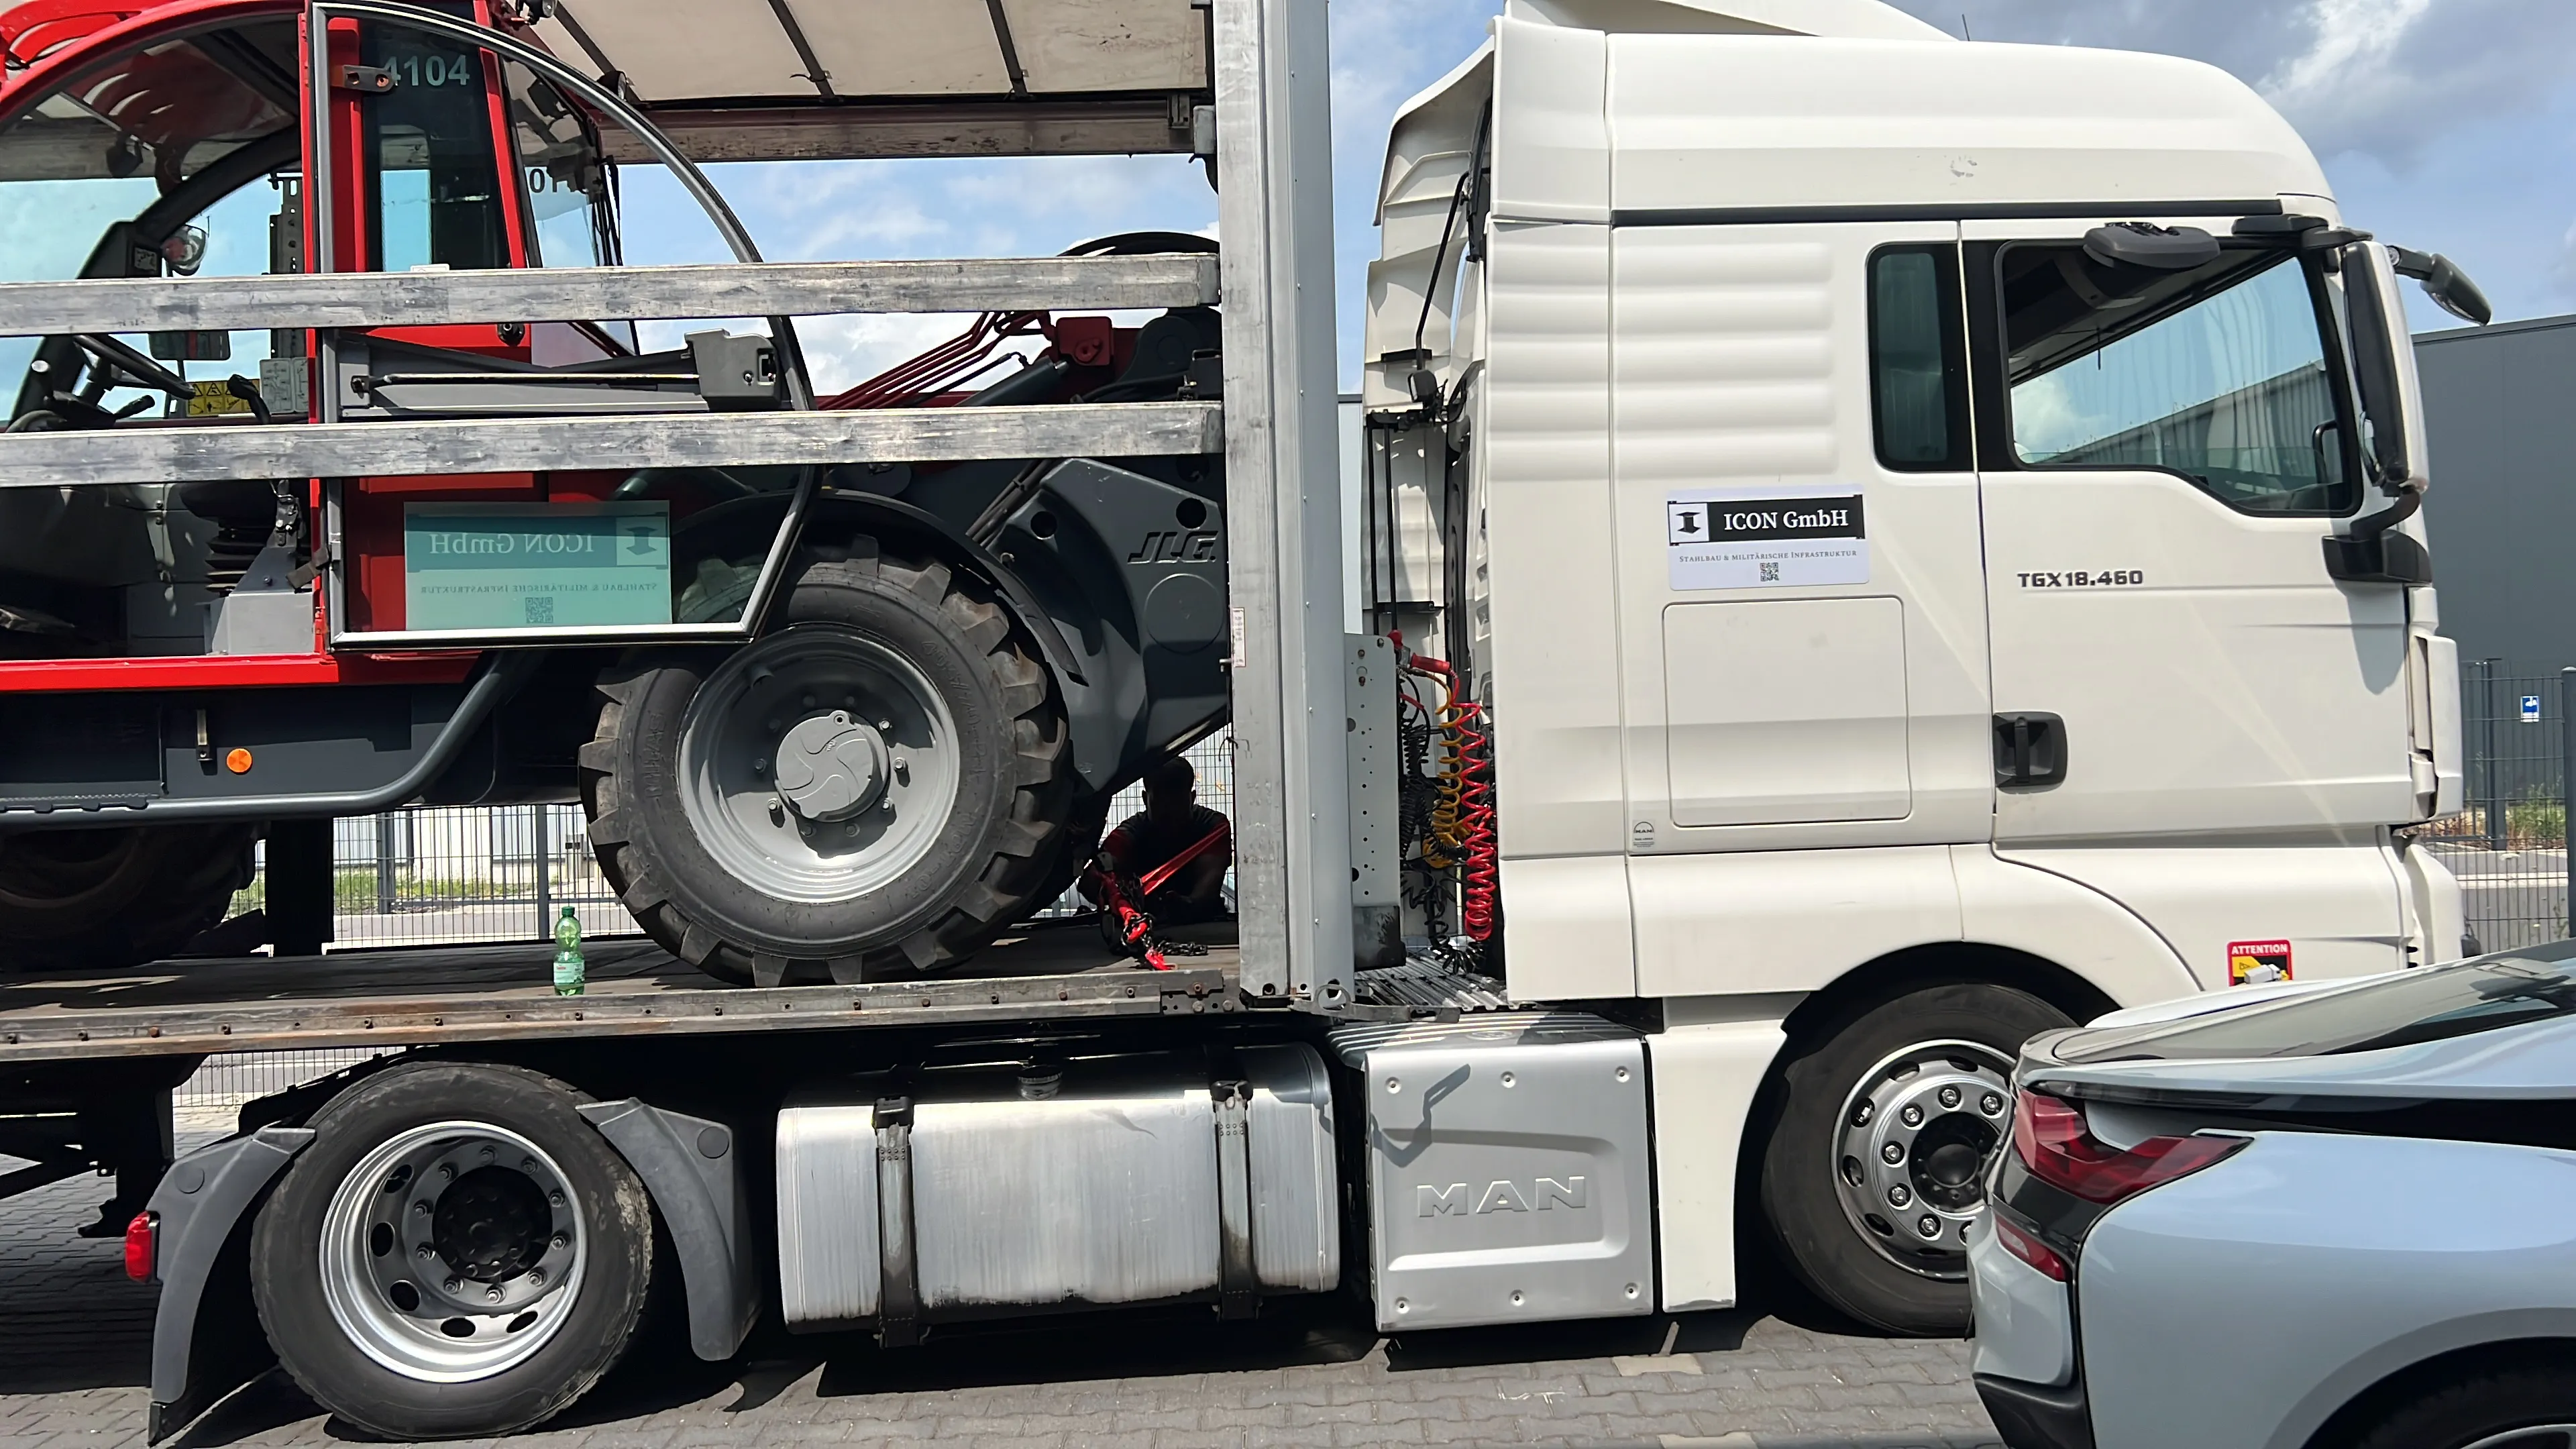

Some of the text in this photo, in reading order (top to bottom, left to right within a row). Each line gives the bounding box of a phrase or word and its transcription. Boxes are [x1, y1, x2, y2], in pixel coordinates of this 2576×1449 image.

[384, 54, 470, 87] 4104
[1723, 508, 1849, 531] ICON GmbH
[1679, 555, 1721, 563] STAHLBAU
[1791, 549, 1858, 559] INFRASTRUKTUR
[2231, 943, 2288, 955] ATTENTION
[1417, 1175, 1586, 1218] MAN
